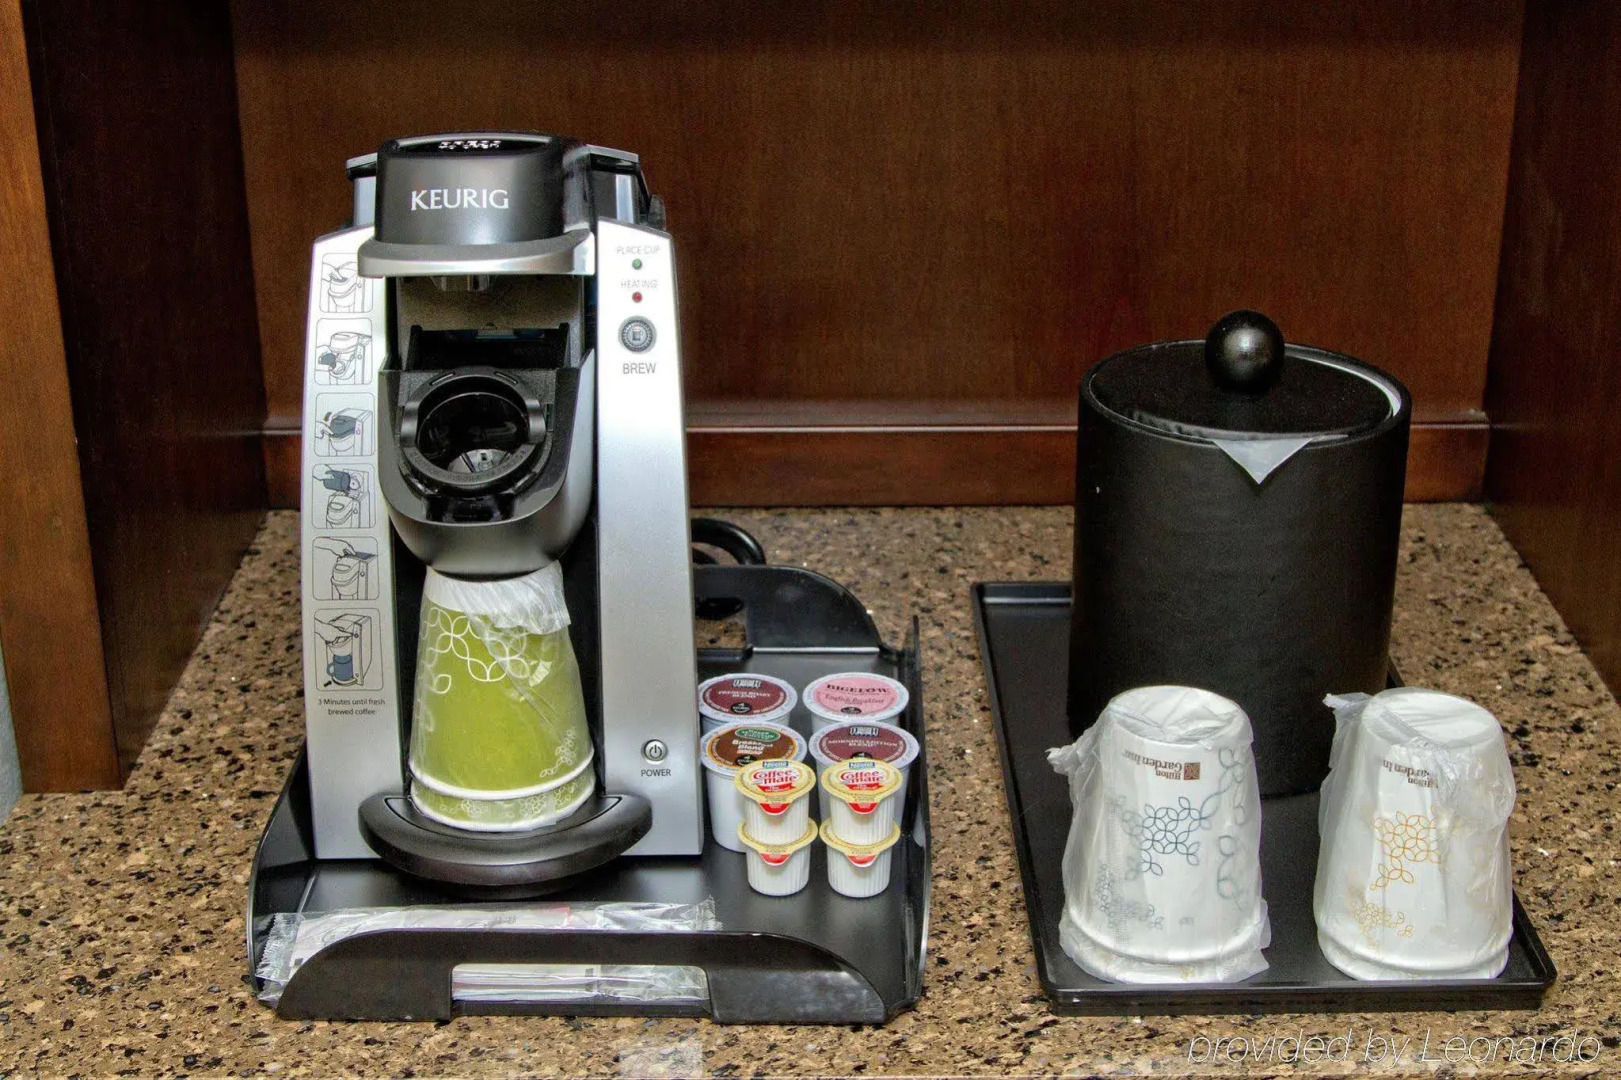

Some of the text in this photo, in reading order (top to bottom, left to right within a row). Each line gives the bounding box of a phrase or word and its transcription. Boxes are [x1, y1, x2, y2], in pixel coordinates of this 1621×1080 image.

[411, 189, 509, 211] KEURIG
[617, 244, 660, 254] PLACE CUP
[620, 279, 658, 288] HEATING
[622, 362, 656, 374] BREW
[318, 697, 386, 706] 3 Minutes until fresh
[328, 707, 376, 716] brewed coffee
[1142, 757, 1182, 773] Garden
[640, 768, 672, 777] POWER
